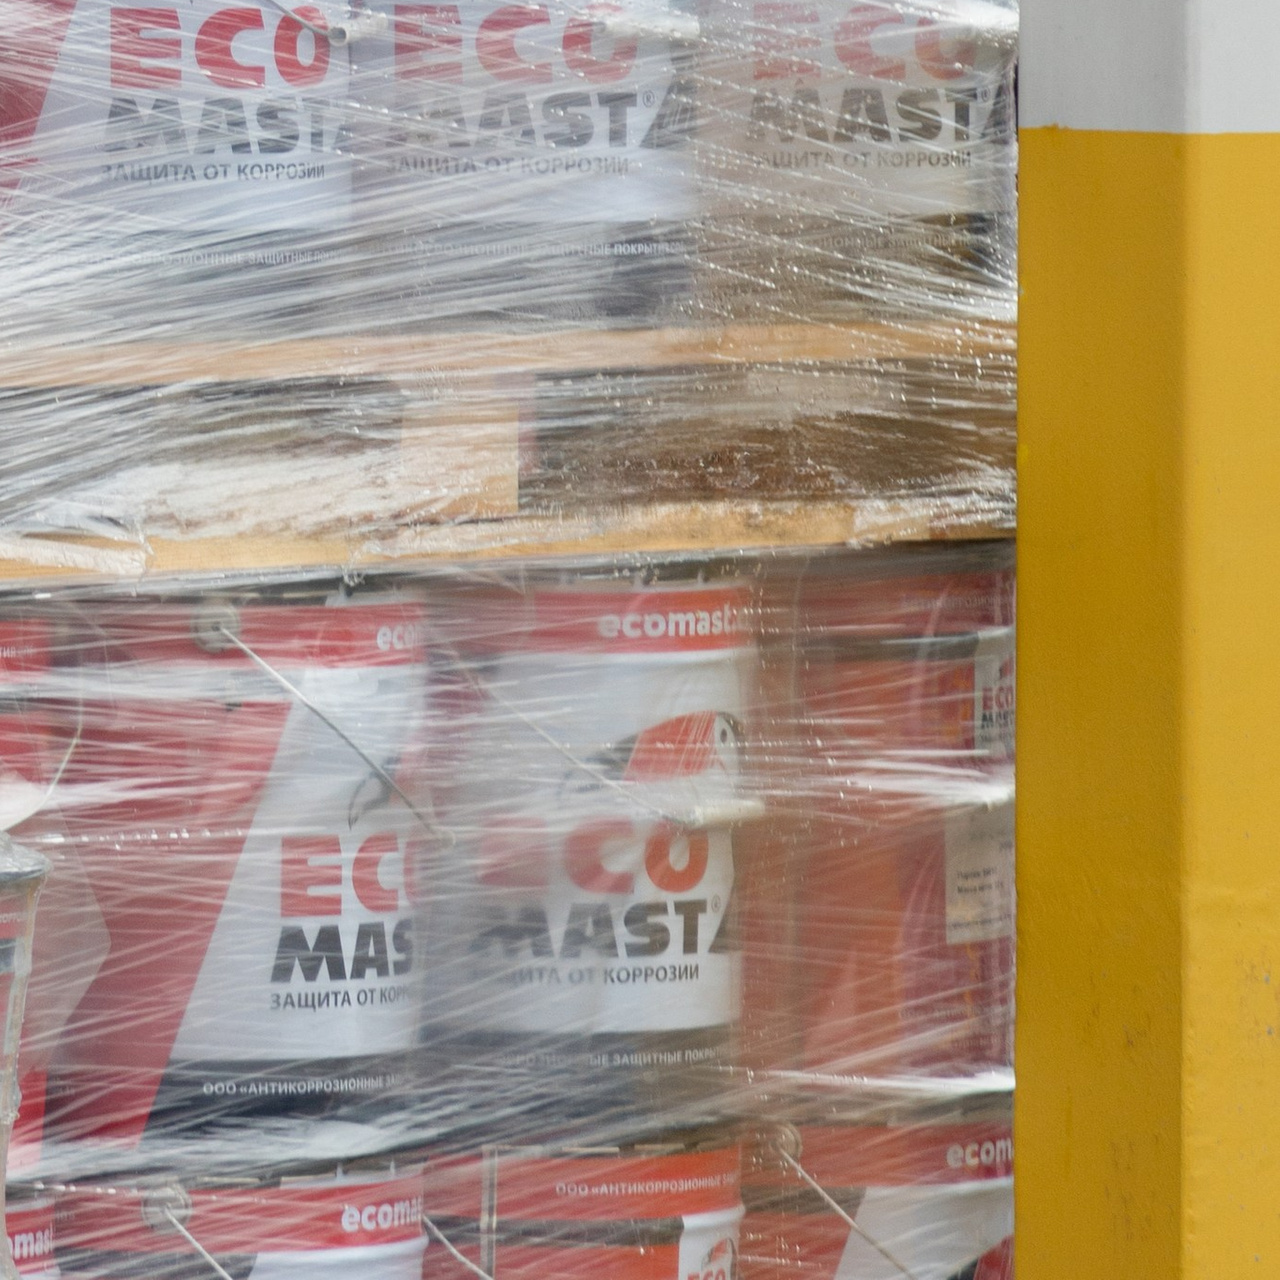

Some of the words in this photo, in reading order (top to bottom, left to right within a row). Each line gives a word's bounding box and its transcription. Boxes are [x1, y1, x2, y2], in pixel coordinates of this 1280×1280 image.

[110, 6, 331, 89] ECO
[394, 2, 638, 85] ECO
[753, 3, 976, 81] ECO
[746, 88, 979, 145] MAST
[203, 163, 230, 181] ОТ
[237, 163, 325, 182] КОРРОЗИИ
[603, 963, 700, 985] КОРРОЗИИ
[271, 991, 353, 1012] ЗАЩИТА
[357, 988, 377, 1007] ОТ
[612, 1049, 683, 1068] ЗАЩИТНЫЕ
[203, 1081, 237, 1095] ООО
